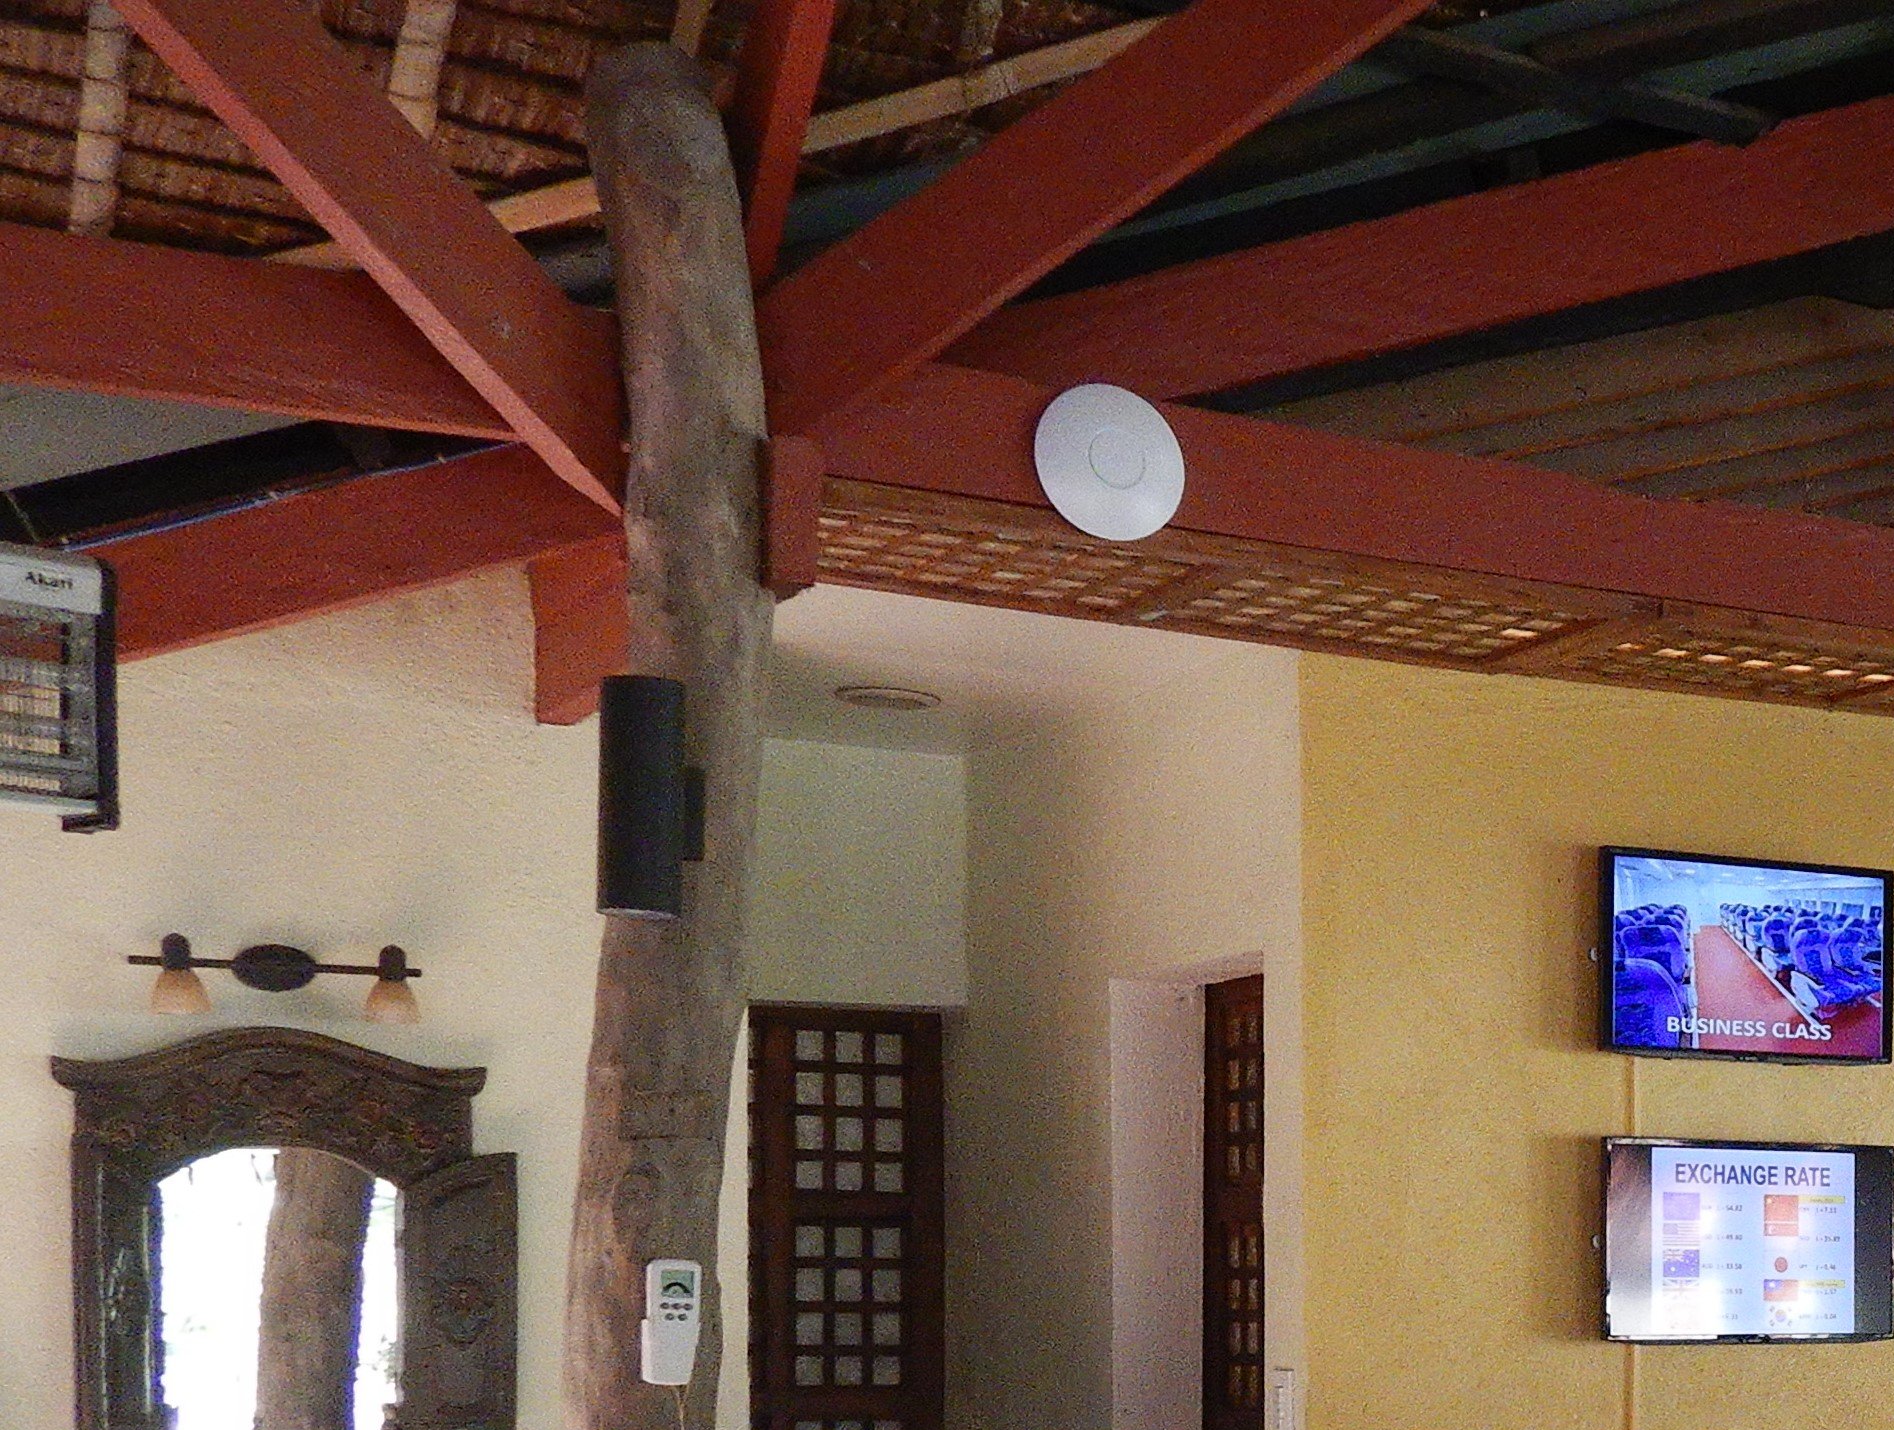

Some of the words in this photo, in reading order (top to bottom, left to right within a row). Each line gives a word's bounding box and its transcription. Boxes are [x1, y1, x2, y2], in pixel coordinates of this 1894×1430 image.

[1666, 1016, 1766, 1037] BUSINESS
[1772, 1022, 1832, 1040] CLASS
[1675, 1163, 1779, 1186] EXCHANGE
[1784, 1166, 1831, 1187] RATE
